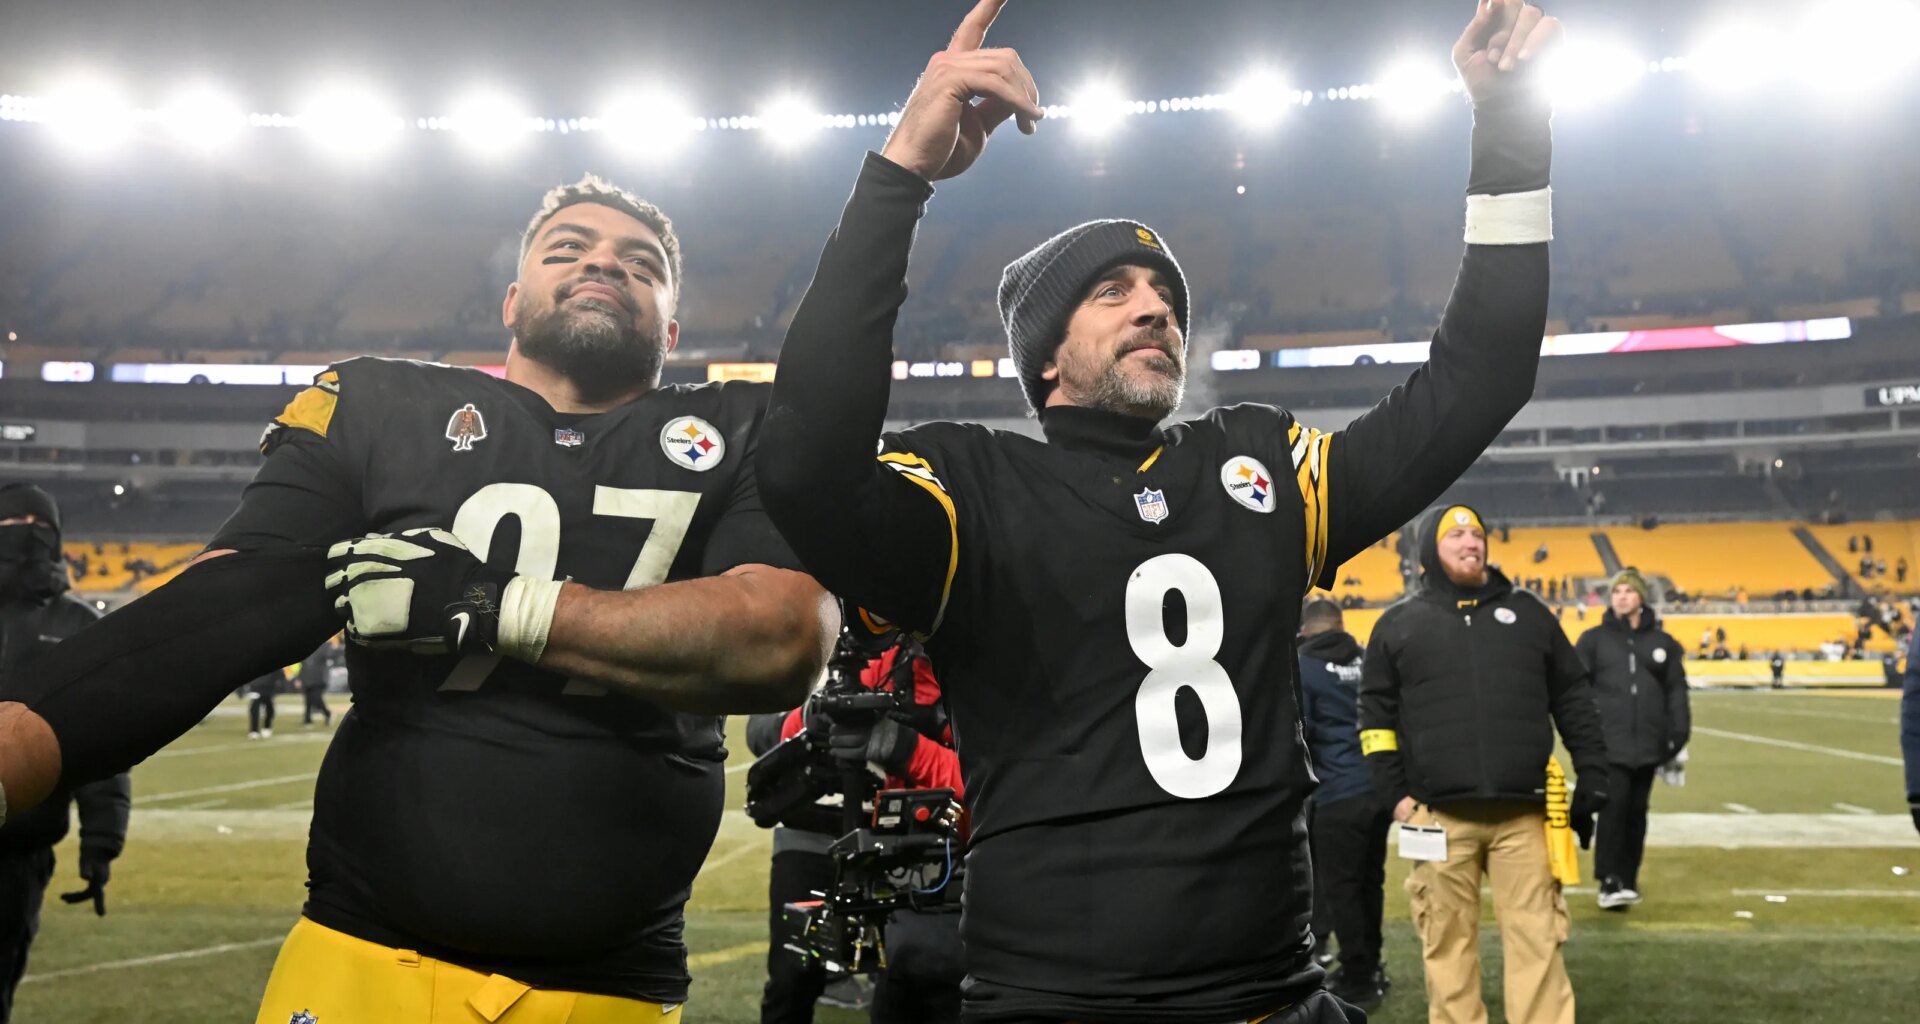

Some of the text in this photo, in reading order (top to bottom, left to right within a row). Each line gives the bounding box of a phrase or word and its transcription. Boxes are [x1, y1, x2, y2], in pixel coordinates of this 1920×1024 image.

[666, 436, 692, 445] Steelers
[1229, 481, 1253, 491] Steelers
[1125, 553, 1243, 799] 8
